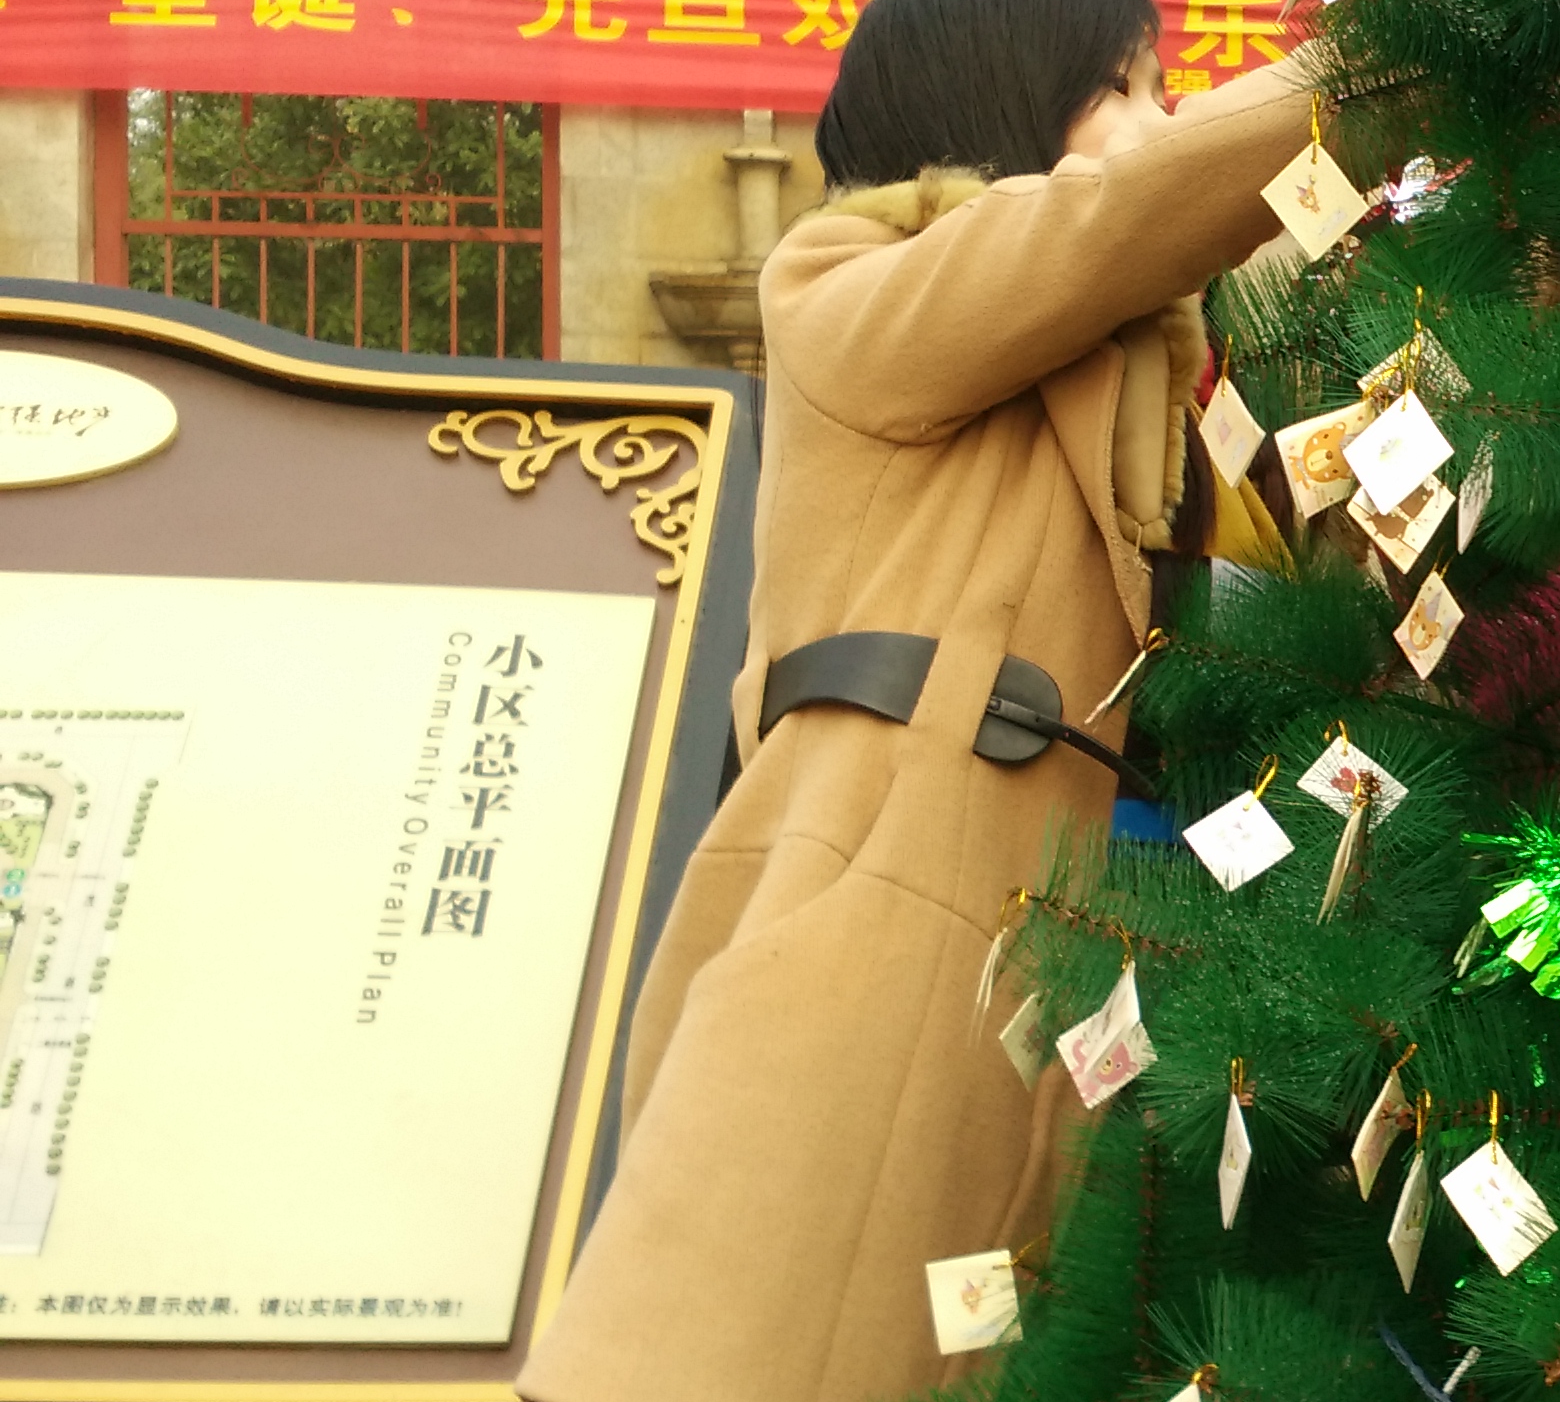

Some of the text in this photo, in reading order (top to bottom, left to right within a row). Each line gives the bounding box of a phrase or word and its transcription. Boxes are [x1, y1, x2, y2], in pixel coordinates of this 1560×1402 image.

[356, 631, 473, 1025] Community Overall Plan
[420, 633, 544, 937] 小区总平面图
